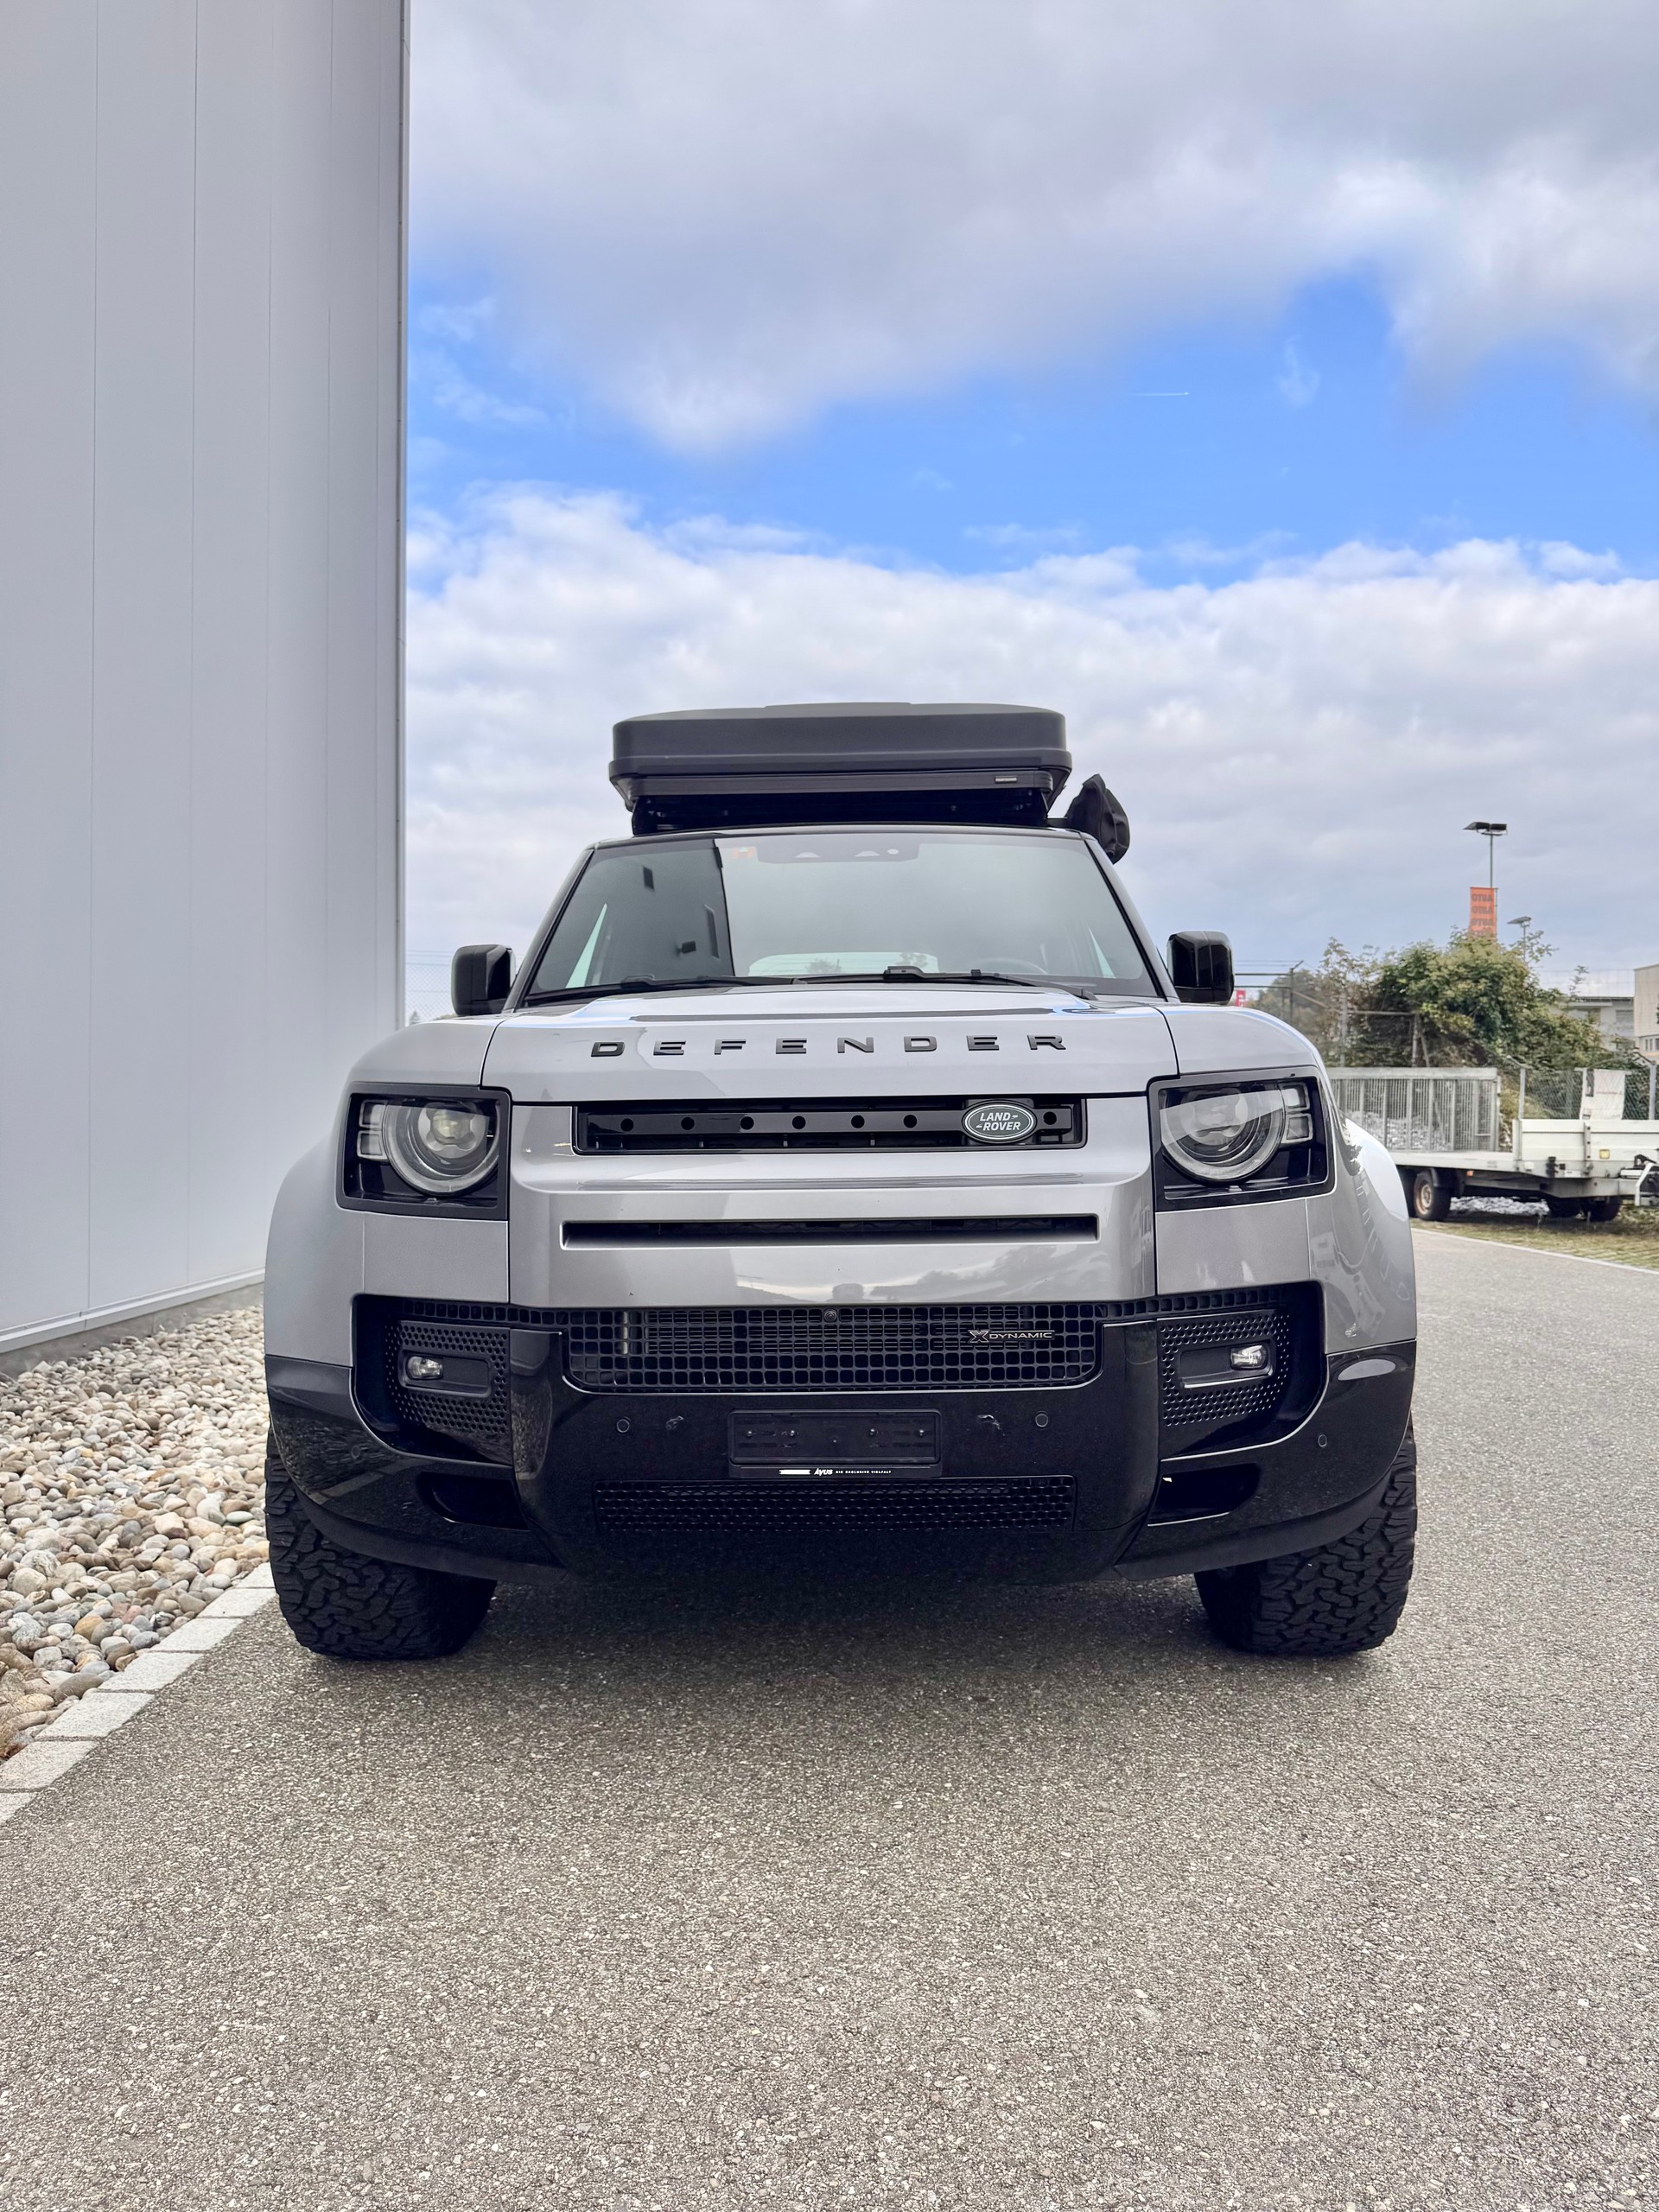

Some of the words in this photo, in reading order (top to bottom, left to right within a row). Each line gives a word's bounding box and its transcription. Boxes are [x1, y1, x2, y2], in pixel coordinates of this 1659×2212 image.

[590, 1034, 1066, 1058] DEFENDER
[980, 1112, 1011, 1122] LAND
[982, 1122, 1021, 1131] ROVER
